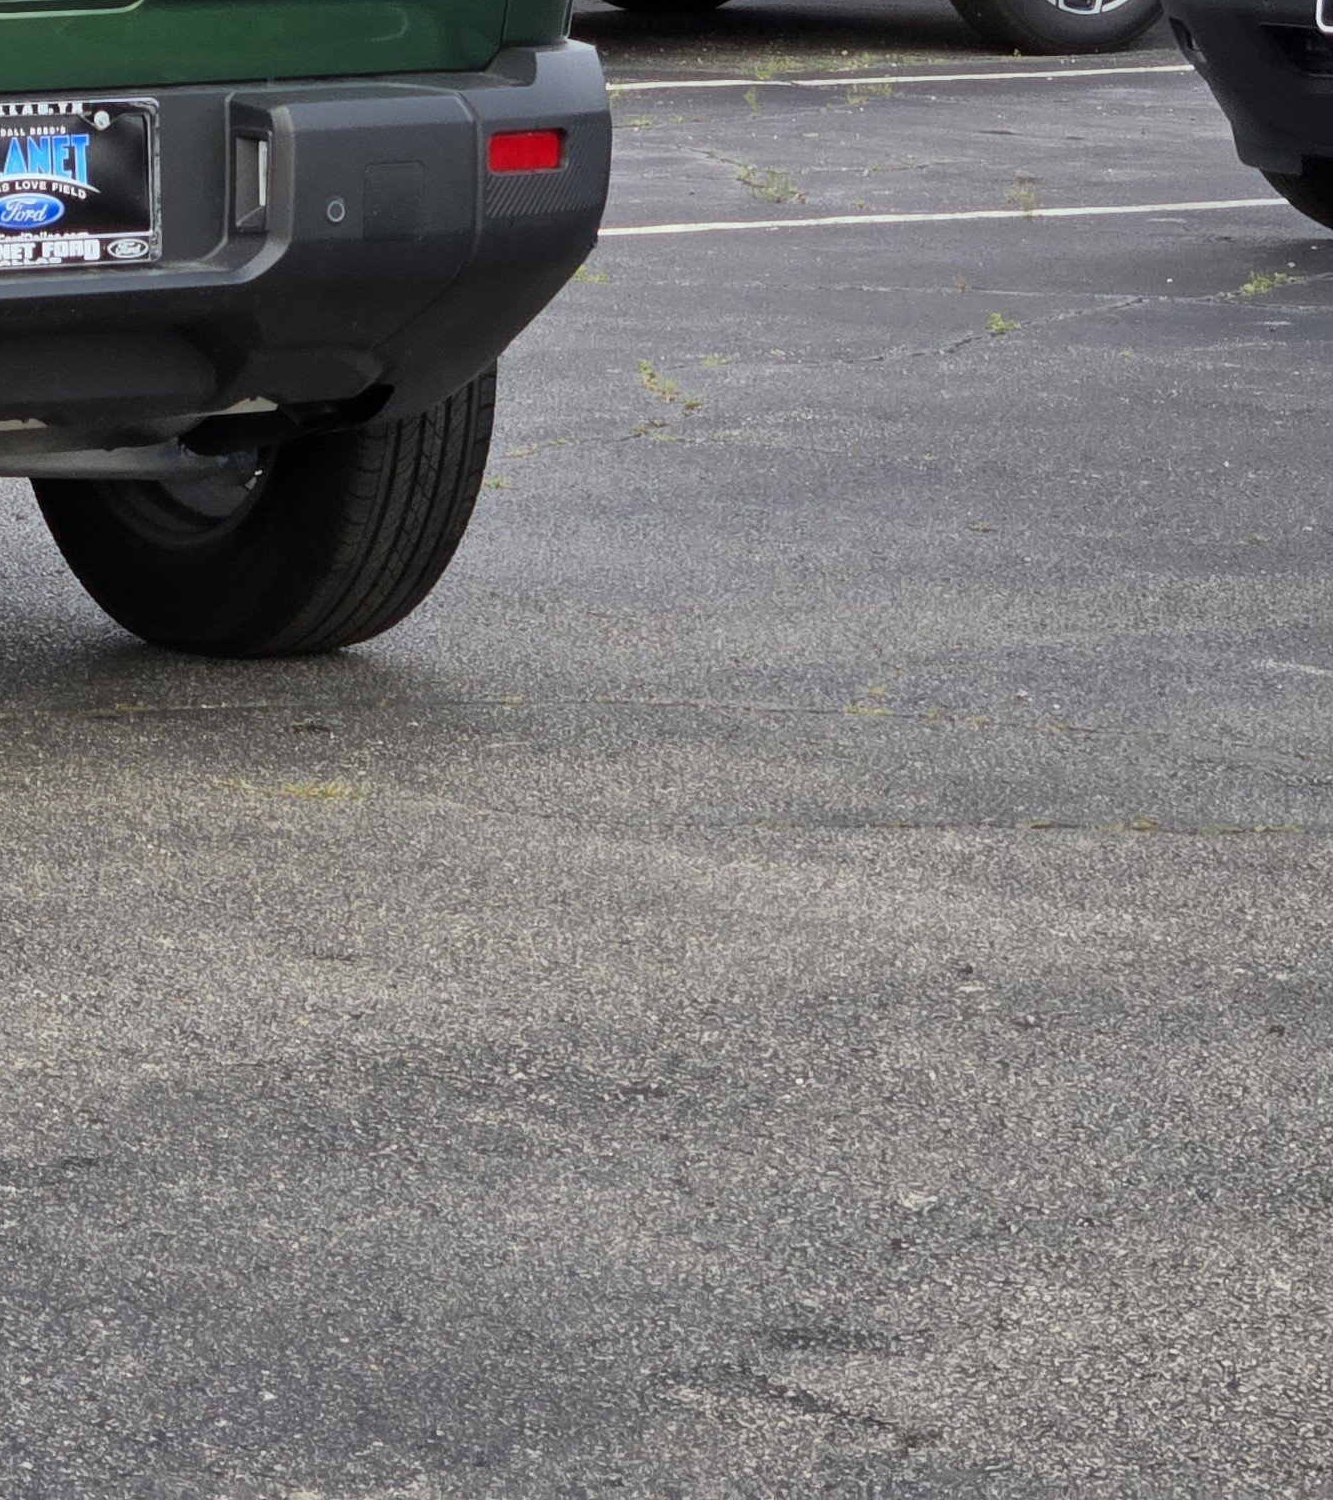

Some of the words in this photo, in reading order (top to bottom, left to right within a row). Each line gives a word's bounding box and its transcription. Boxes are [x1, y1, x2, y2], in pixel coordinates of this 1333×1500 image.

[15, 180, 48, 191] LOVE
[51, 182, 88, 200] FIELD
[0, 200, 49, 223] Ford
[42, 239, 101, 261] FORD
